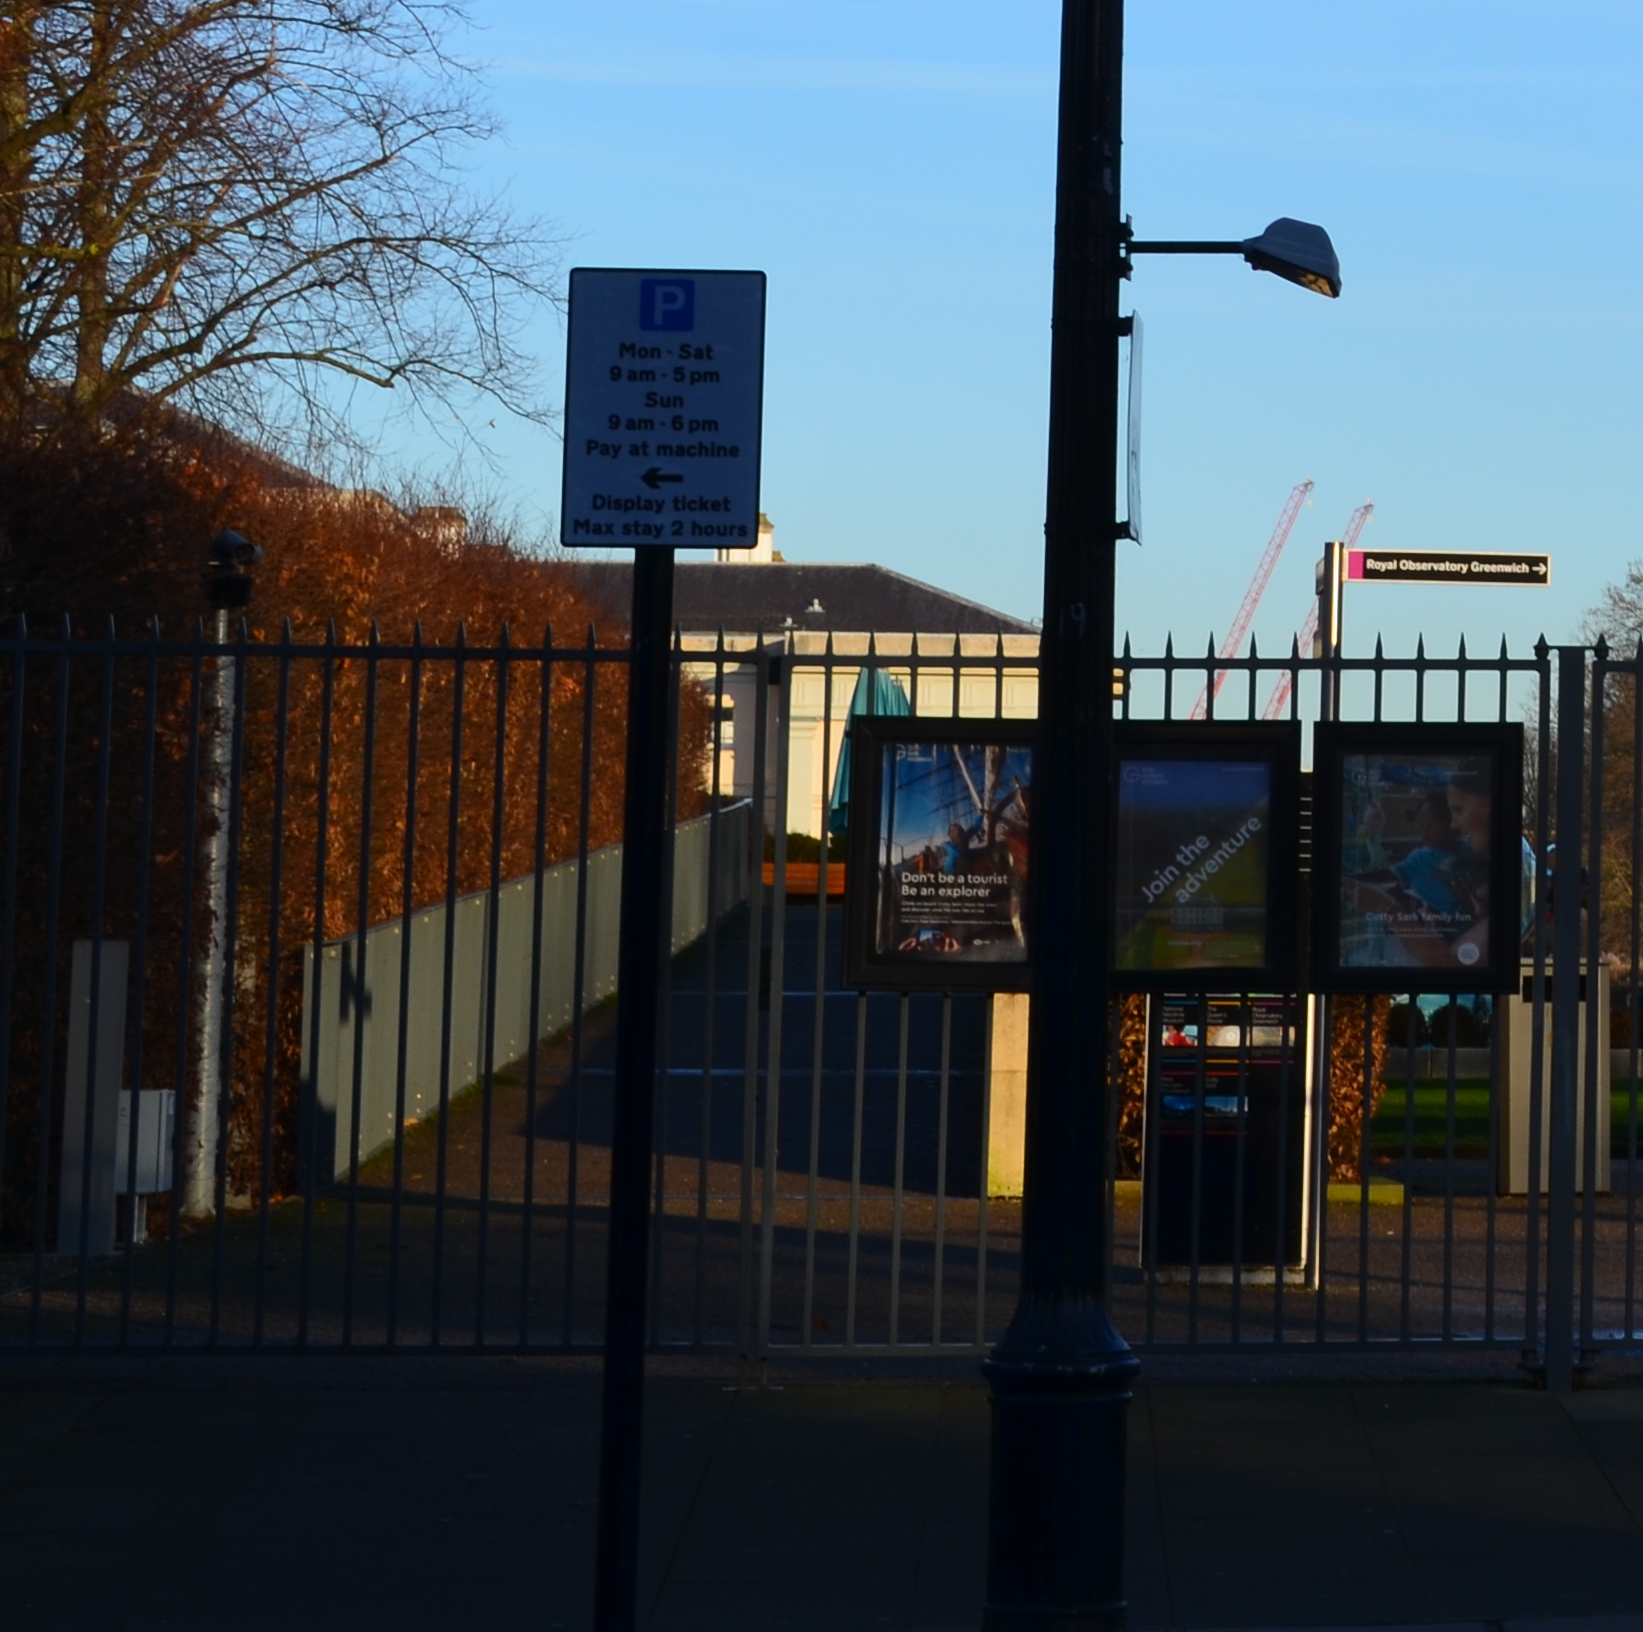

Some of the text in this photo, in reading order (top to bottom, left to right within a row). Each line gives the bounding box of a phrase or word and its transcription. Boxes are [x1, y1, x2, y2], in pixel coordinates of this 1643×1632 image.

[653, 284, 686, 326] P
[618, 342, 662, 360] Mon
[678, 343, 714, 361] Sat
[609, 366, 623, 382] 9
[627, 369, 656, 383] am
[673, 367, 686, 383] 5
[689, 370, 720, 387] pm
[644, 391, 685, 409] Sun
[607, 414, 621, 431] 9
[625, 418, 655, 432] am
[671, 415, 684, 432] 6
[688, 419, 719, 435] pm
[586, 439, 741, 460] Pay at machine
[591, 493, 732, 515] Display ticket
[573, 519, 749, 540] Max stay 2 hours
[1365, 557, 1531, 575] Royal Observatory Greenwich
[1140, 833, 1211, 904] Join the
[1174, 816, 1263, 904] adventure
[901, 871, 1009, 885] Don't be a tourist
[901, 885, 991, 899] Be an explorer
[1365, 910, 1472, 924] Cutty Sark family fun
